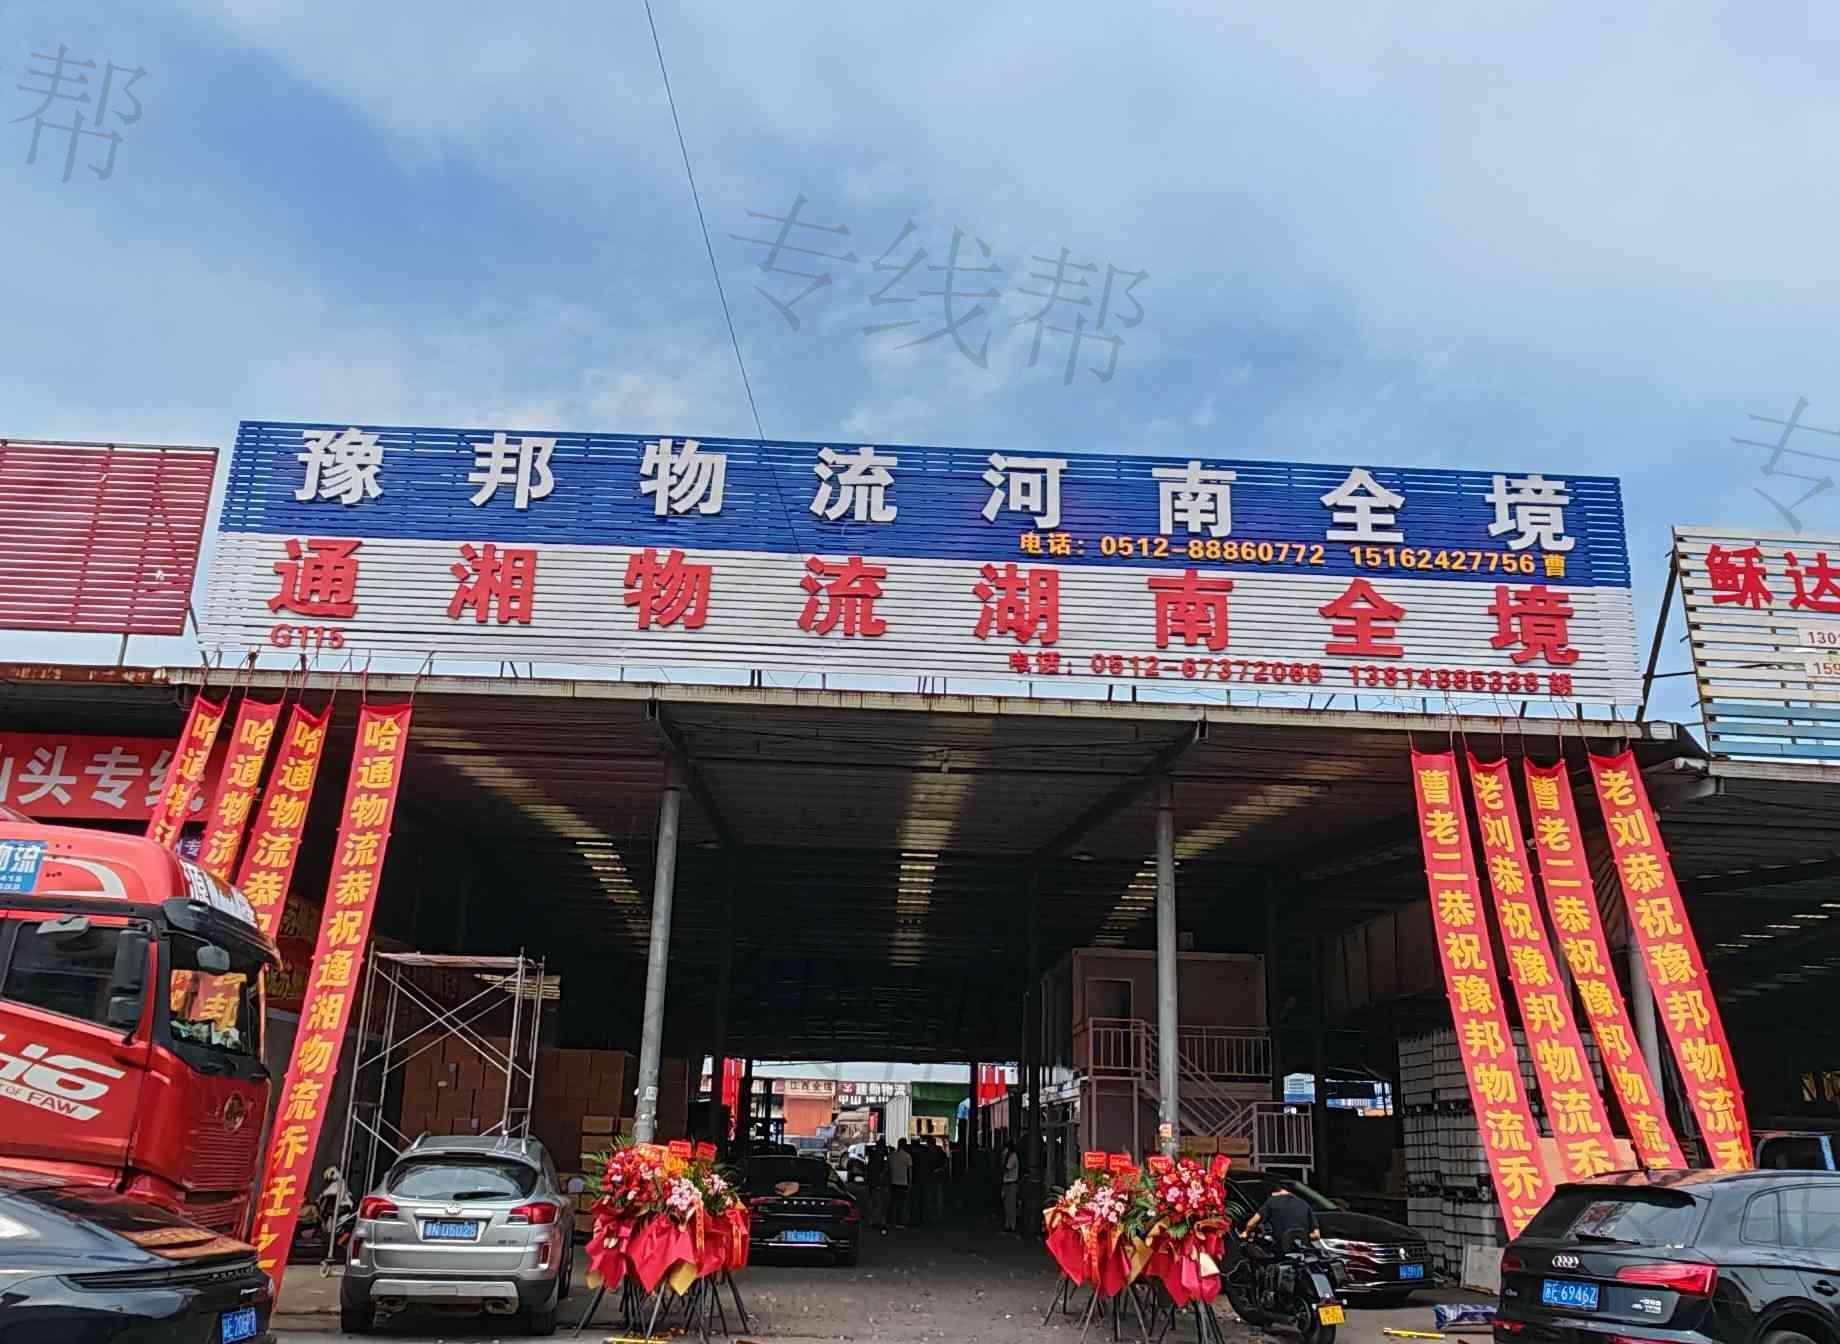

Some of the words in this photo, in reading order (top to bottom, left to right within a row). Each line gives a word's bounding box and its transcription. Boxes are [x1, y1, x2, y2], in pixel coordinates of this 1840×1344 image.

[295, 428, 1576, 552] 豫邦物流河南全境
[1350, 545, 1536, 573] 15162427756
[266, 538, 1581, 666] 通湘物流湖南全境
[271, 623, 345, 650] G115
[27, 1091, 80, 1114] FAW
